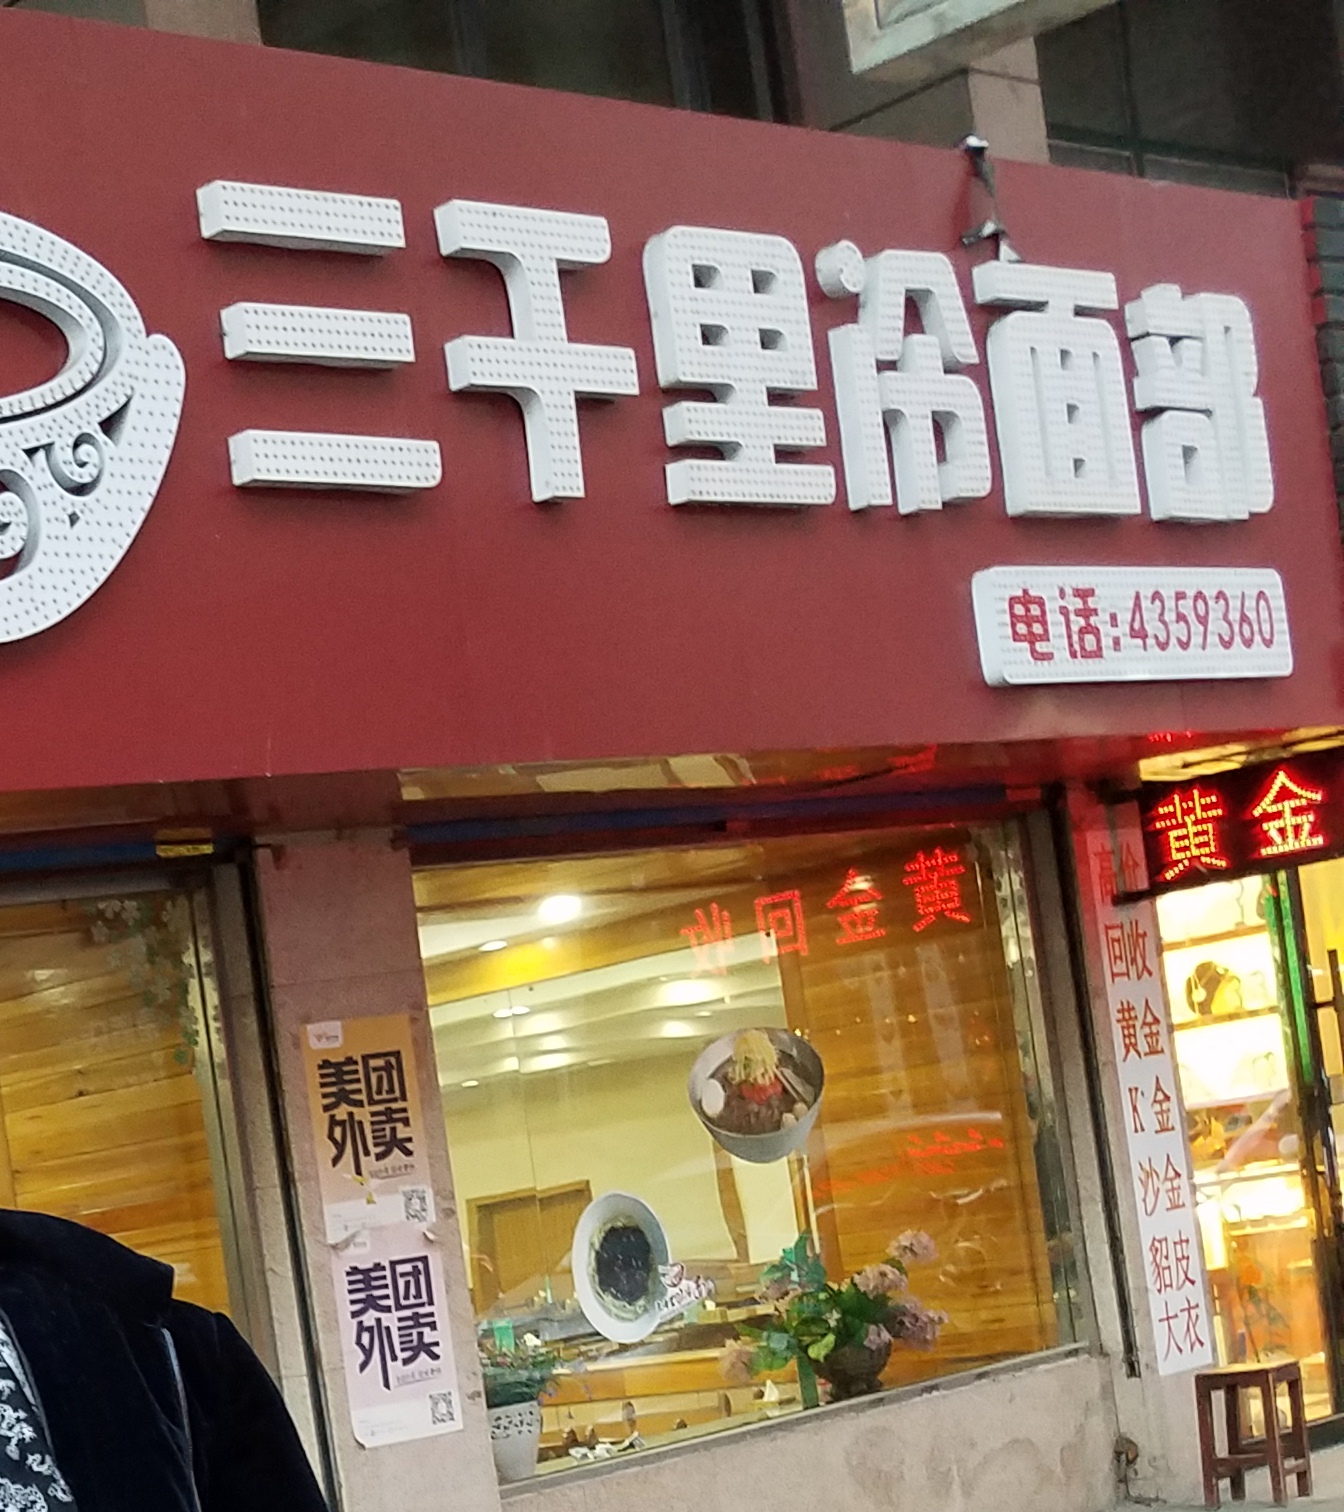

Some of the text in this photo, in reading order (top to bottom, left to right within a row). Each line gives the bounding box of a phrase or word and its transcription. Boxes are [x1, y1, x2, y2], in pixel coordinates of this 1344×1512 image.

[196, 178, 1276, 522] 三千里冷面部
[1154, 769, 1324, 881] 黄金
[1104, 919, 1153, 984] 回收
[1115, 997, 1165, 1062] 黄金
[316, 1049, 408, 1113] 美团
[325, 1107, 414, 1177] 外卖
[1138, 1152, 1186, 1217] 沙金
[344, 1254, 436, 1320] 美团
[354, 1311, 442, 1391] 外卖
[1158, 1295, 1205, 1362] 大衣
